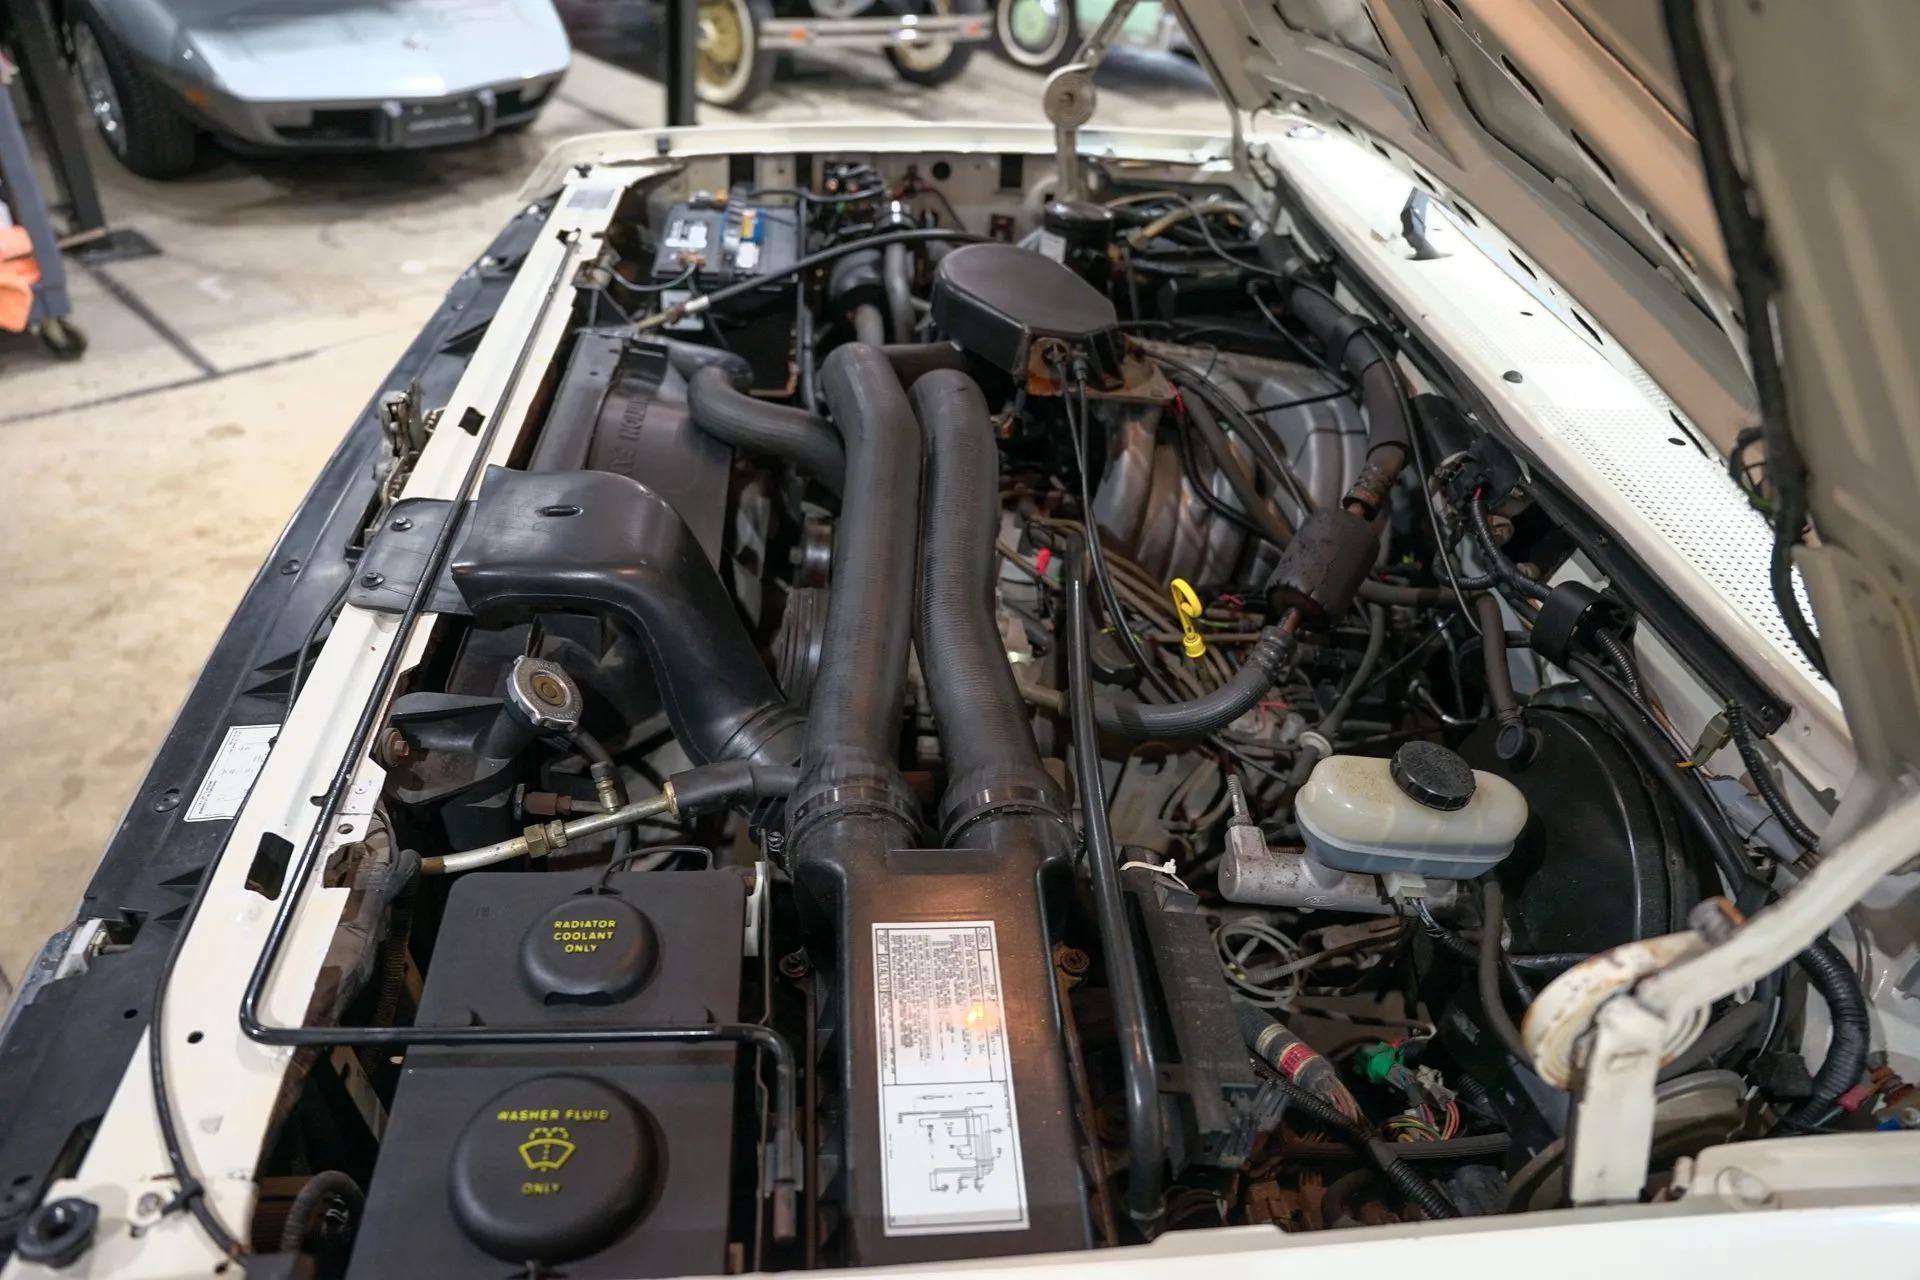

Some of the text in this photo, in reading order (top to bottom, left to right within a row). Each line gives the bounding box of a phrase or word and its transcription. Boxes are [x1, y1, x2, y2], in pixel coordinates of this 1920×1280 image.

[553, 919, 617, 929] RADIATOR
[553, 931, 615, 941] COOLANT
[564, 944, 598, 953] ONLY
[879, 955, 890, 990] CATALYST
[497, 1108, 610, 1121] WASHER FLUID
[520, 1182, 561, 1195] ONLY
